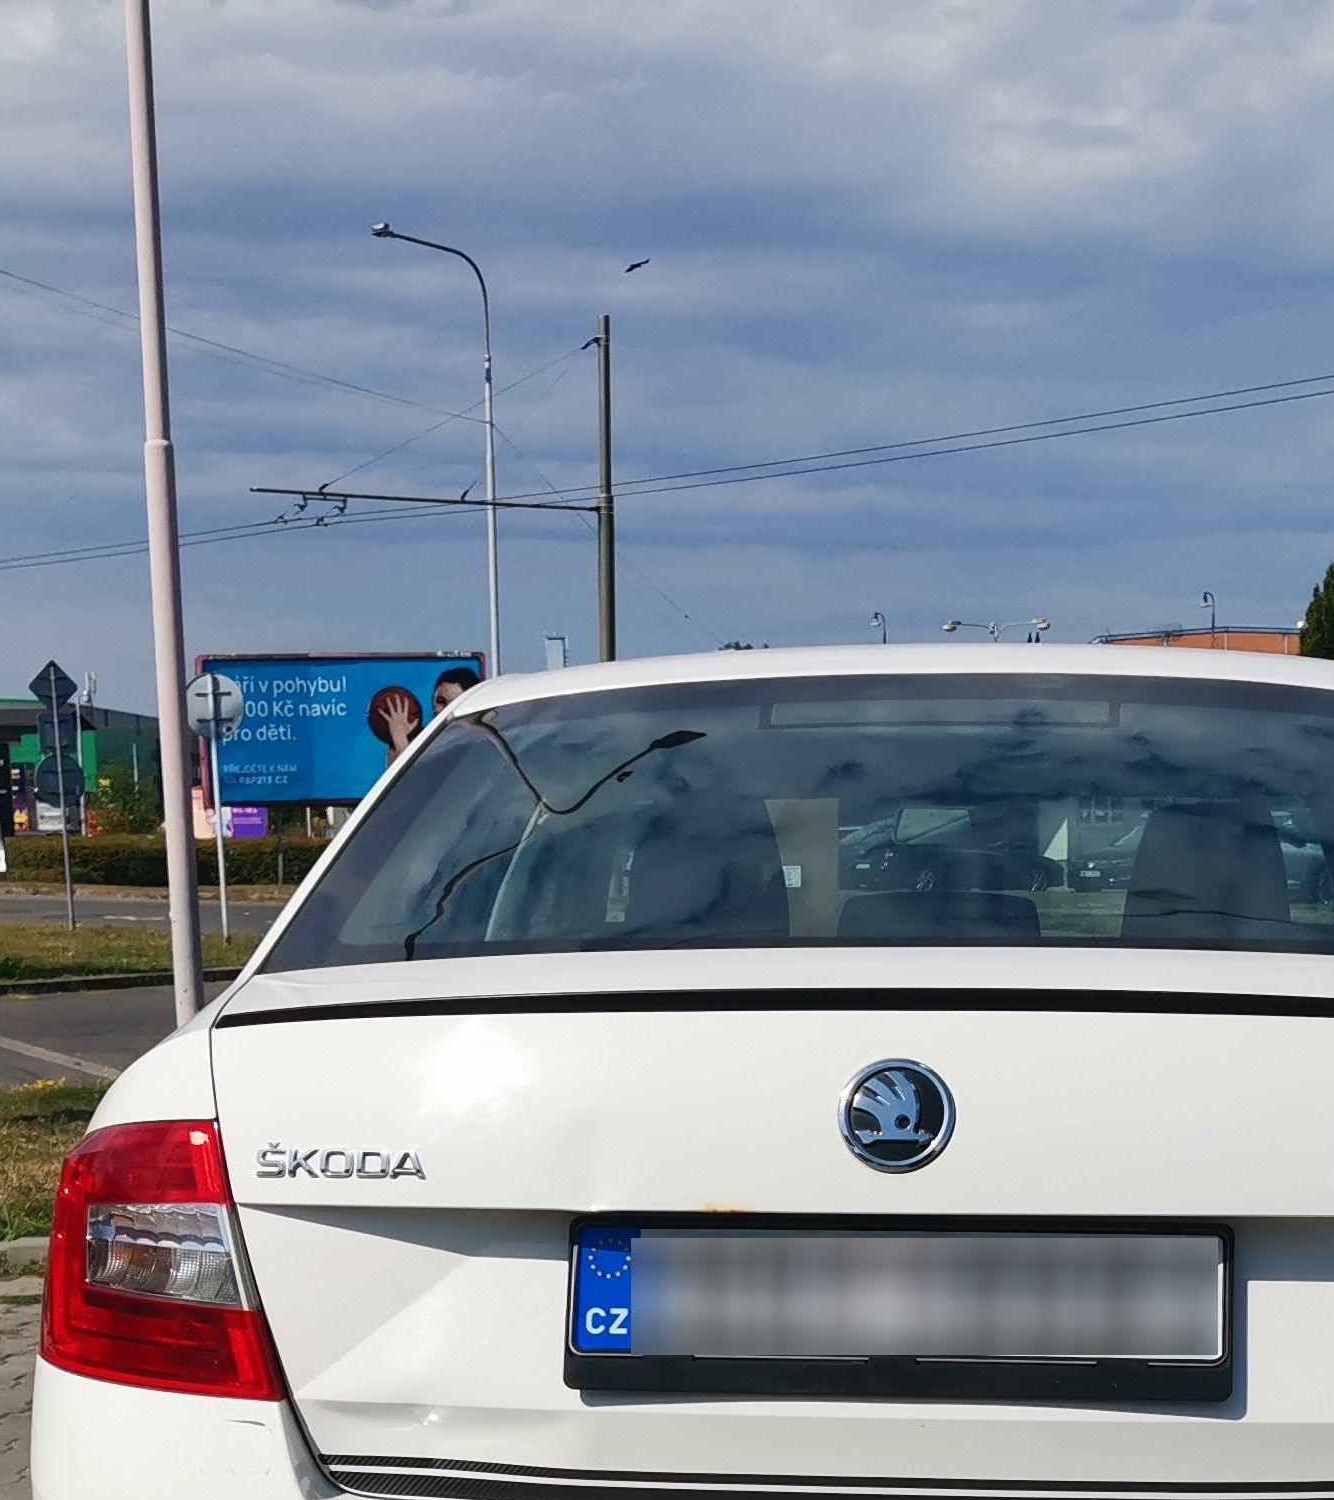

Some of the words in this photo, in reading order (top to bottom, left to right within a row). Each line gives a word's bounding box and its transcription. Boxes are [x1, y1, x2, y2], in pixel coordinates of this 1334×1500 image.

[259, 681, 269, 693] v
[273, 675, 347, 698] pohybu!
[273, 699, 295, 718] Kč
[299, 698, 347, 718] navíc
[256, 723, 297, 742] děti.
[256, 1141, 427, 1181] ŠKODA
[584, 1307, 629, 1335] CZ
